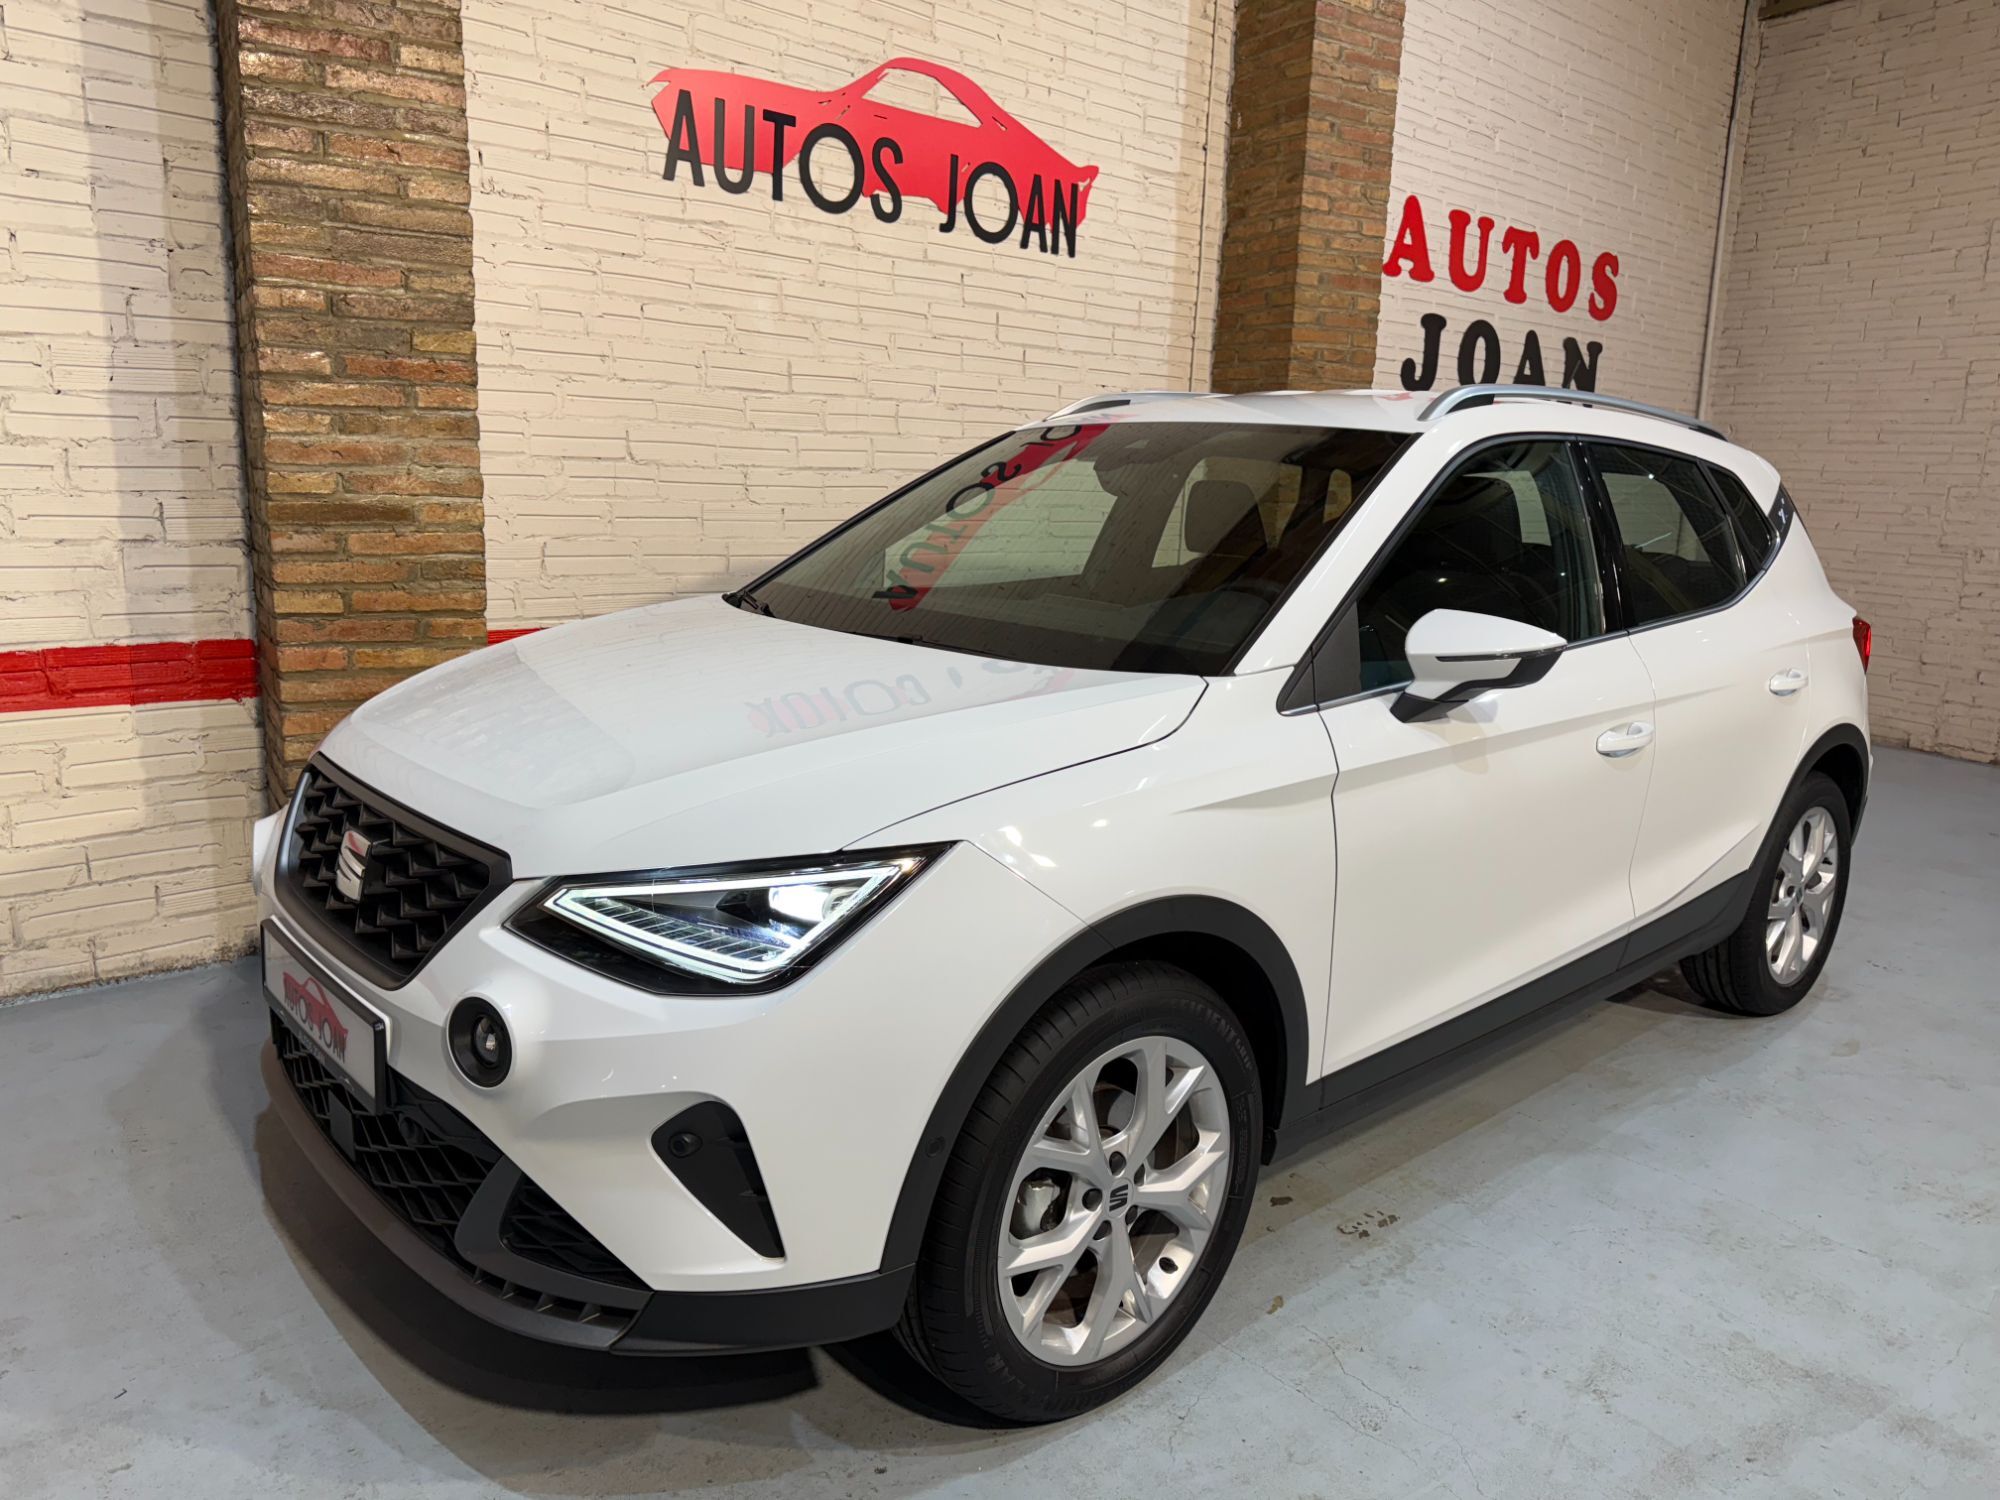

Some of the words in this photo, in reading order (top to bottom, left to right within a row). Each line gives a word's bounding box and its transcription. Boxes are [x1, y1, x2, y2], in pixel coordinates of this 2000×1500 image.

[662, 88, 904, 223] AUTOS
[939, 153, 1079, 258] JOAN
[1381, 194, 1619, 321] AUTOS
[1400, 312, 1604, 396] JOAN
